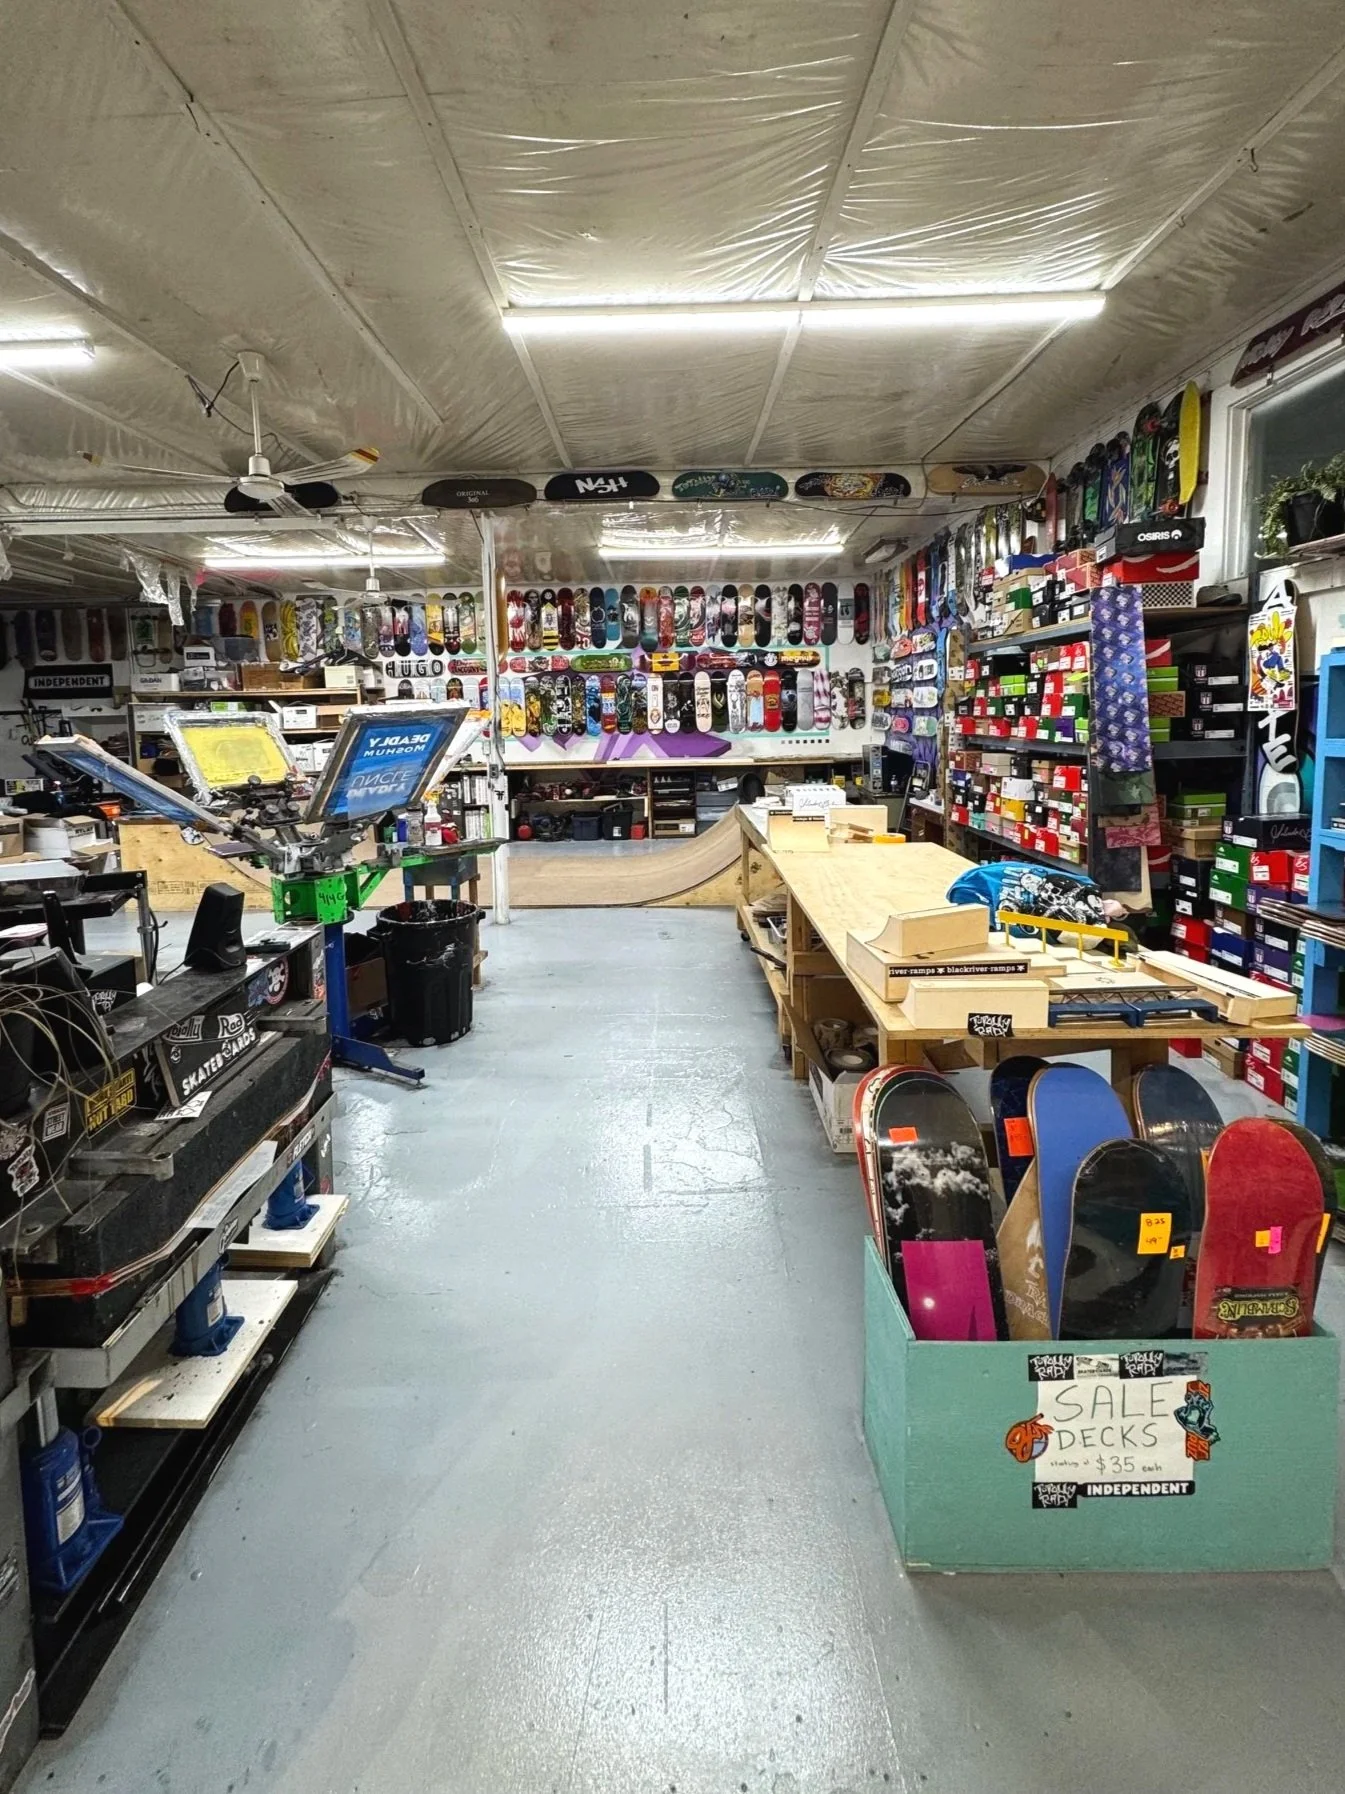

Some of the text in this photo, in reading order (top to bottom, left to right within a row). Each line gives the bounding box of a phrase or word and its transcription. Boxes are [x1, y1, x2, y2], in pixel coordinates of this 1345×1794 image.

[1137, 531, 1170, 542] OSIRIS
[386, 659, 444, 678] HUGO
[34, 676, 105, 688] INDEPENDENT
[1053, 1381, 1173, 1423] SALE
[1056, 1422, 1158, 1451] DECKS
[1095, 1453, 1136, 1475] $35
[1141, 1463, 1162, 1473] each
[1087, 1482, 1189, 1496] INDEPENDENT
